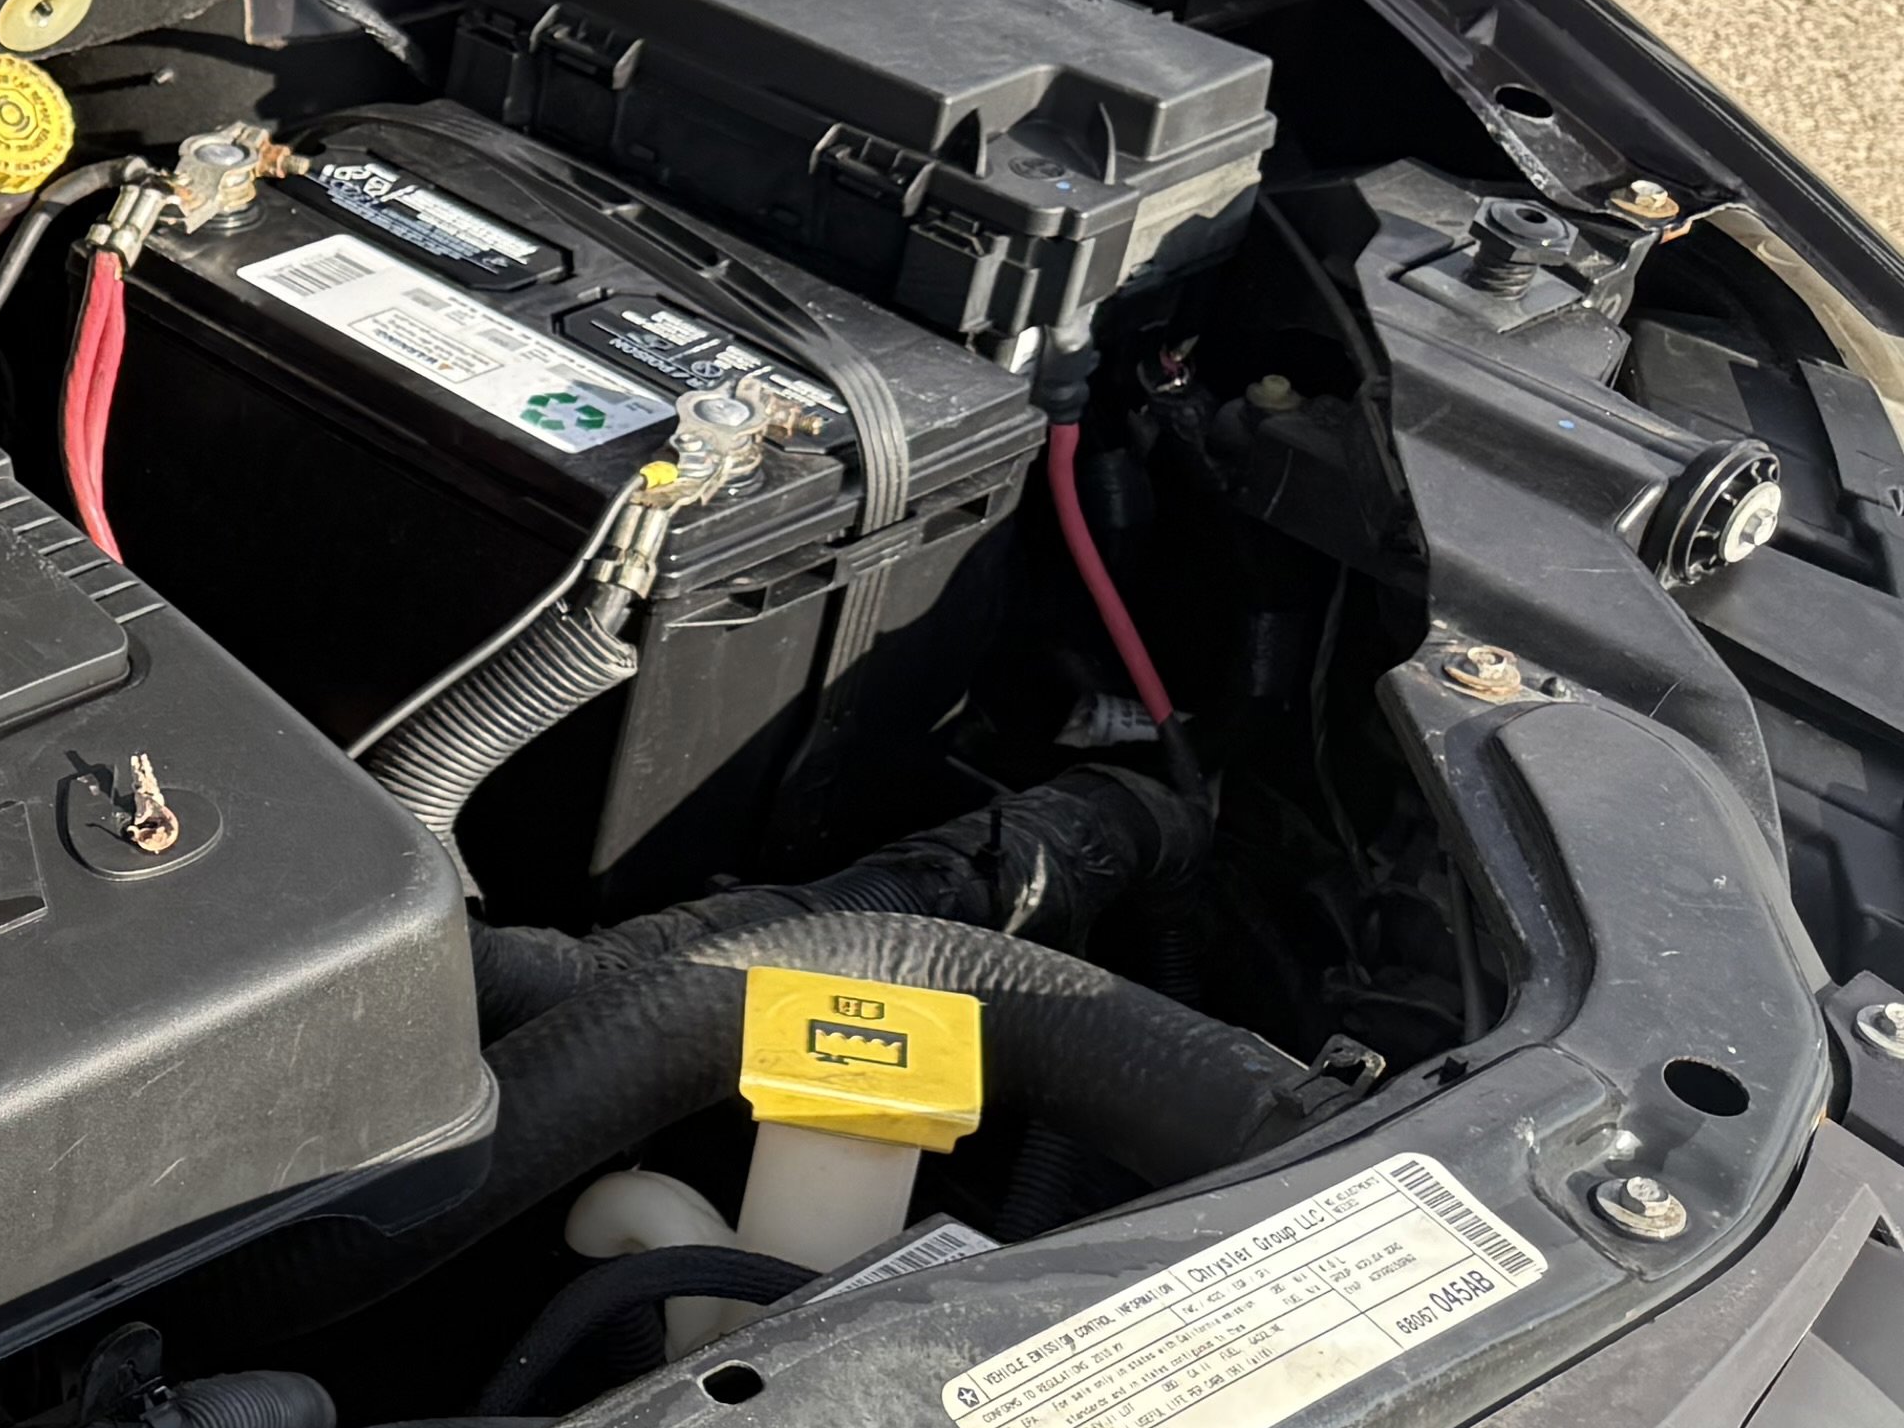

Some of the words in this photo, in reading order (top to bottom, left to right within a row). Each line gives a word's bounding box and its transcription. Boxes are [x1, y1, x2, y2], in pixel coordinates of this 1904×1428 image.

[1184, 1243, 1258, 1287] Chrysler
[1249, 1222, 1303, 1255] Group
[1291, 1208, 1327, 1230] LLC
[981, 1356, 1029, 1387] VEHICLE
[1072, 1312, 1116, 1339] CONTROL
[1114, 1282, 1175, 1317] INFORMATION
[1393, 1305, 1441, 1335] 68067
[1425, 1268, 1497, 1314] 045AB
[1022, 1388, 1037, 1401] TO
[1034, 1360, 1091, 1394] REGULATIONS
